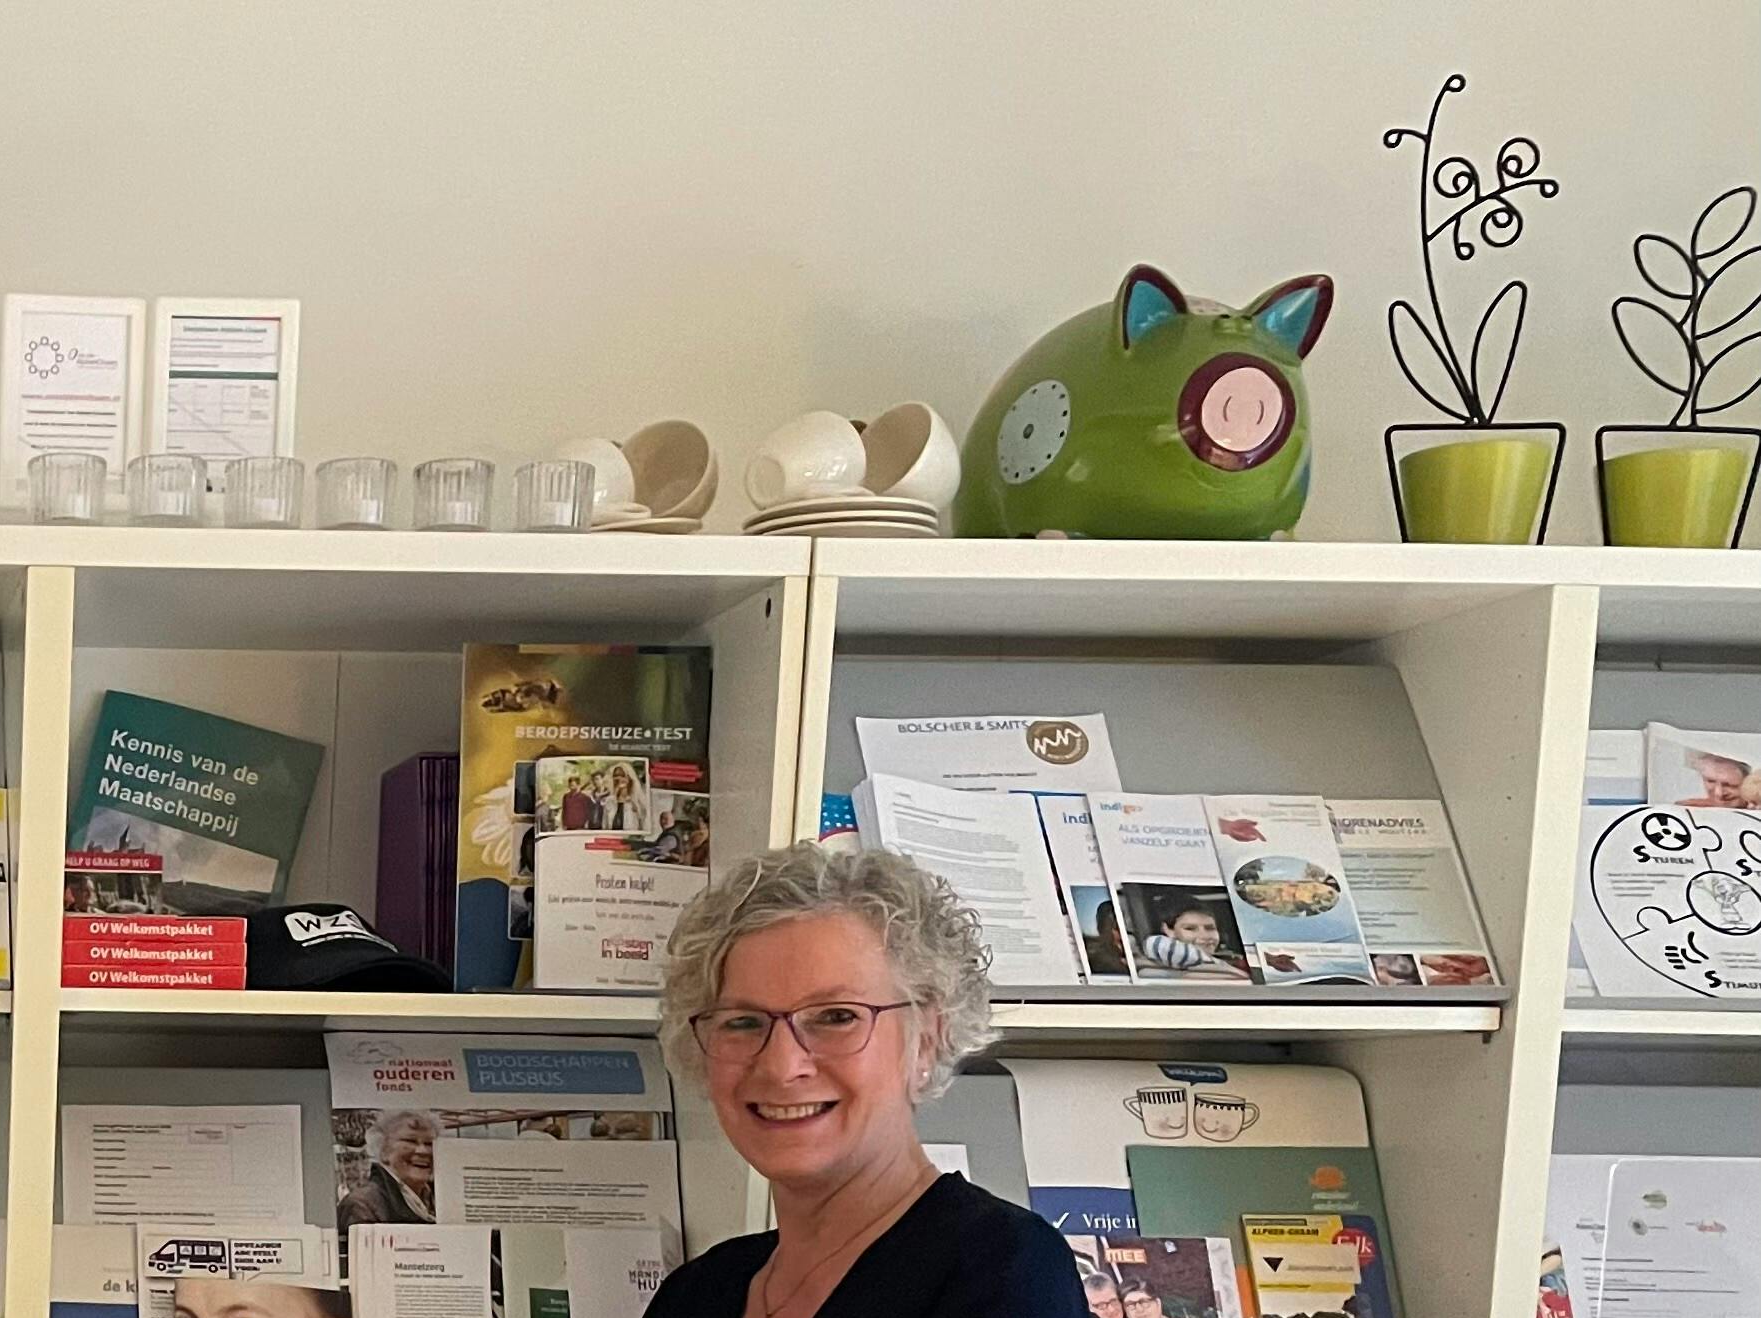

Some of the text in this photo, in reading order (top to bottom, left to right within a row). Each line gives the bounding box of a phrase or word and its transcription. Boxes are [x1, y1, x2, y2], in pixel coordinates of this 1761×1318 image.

[897, 719, 1030, 734] BOLSCHER & SMITS
[109, 728, 260, 785] Kennis van de
[103, 753, 238, 805] Nederlandse
[97, 776, 240, 838] Maatschappij
[89, 922, 214, 938] OV Welkomstpakket
[89, 947, 214, 962] OV Welkomstpakket
[88, 971, 213, 986] OV Welkomstpakket
[476, 1054, 631, 1070] BOODSCHAPPEN
[373, 1067, 456, 1082] ouderen
[478, 1070, 564, 1087] PLUSBUS
[375, 1081, 414, 1093] fonds
[1081, 1212, 1123, 1232] Vrije
[394, 1262, 447, 1274] Mantelzorg
